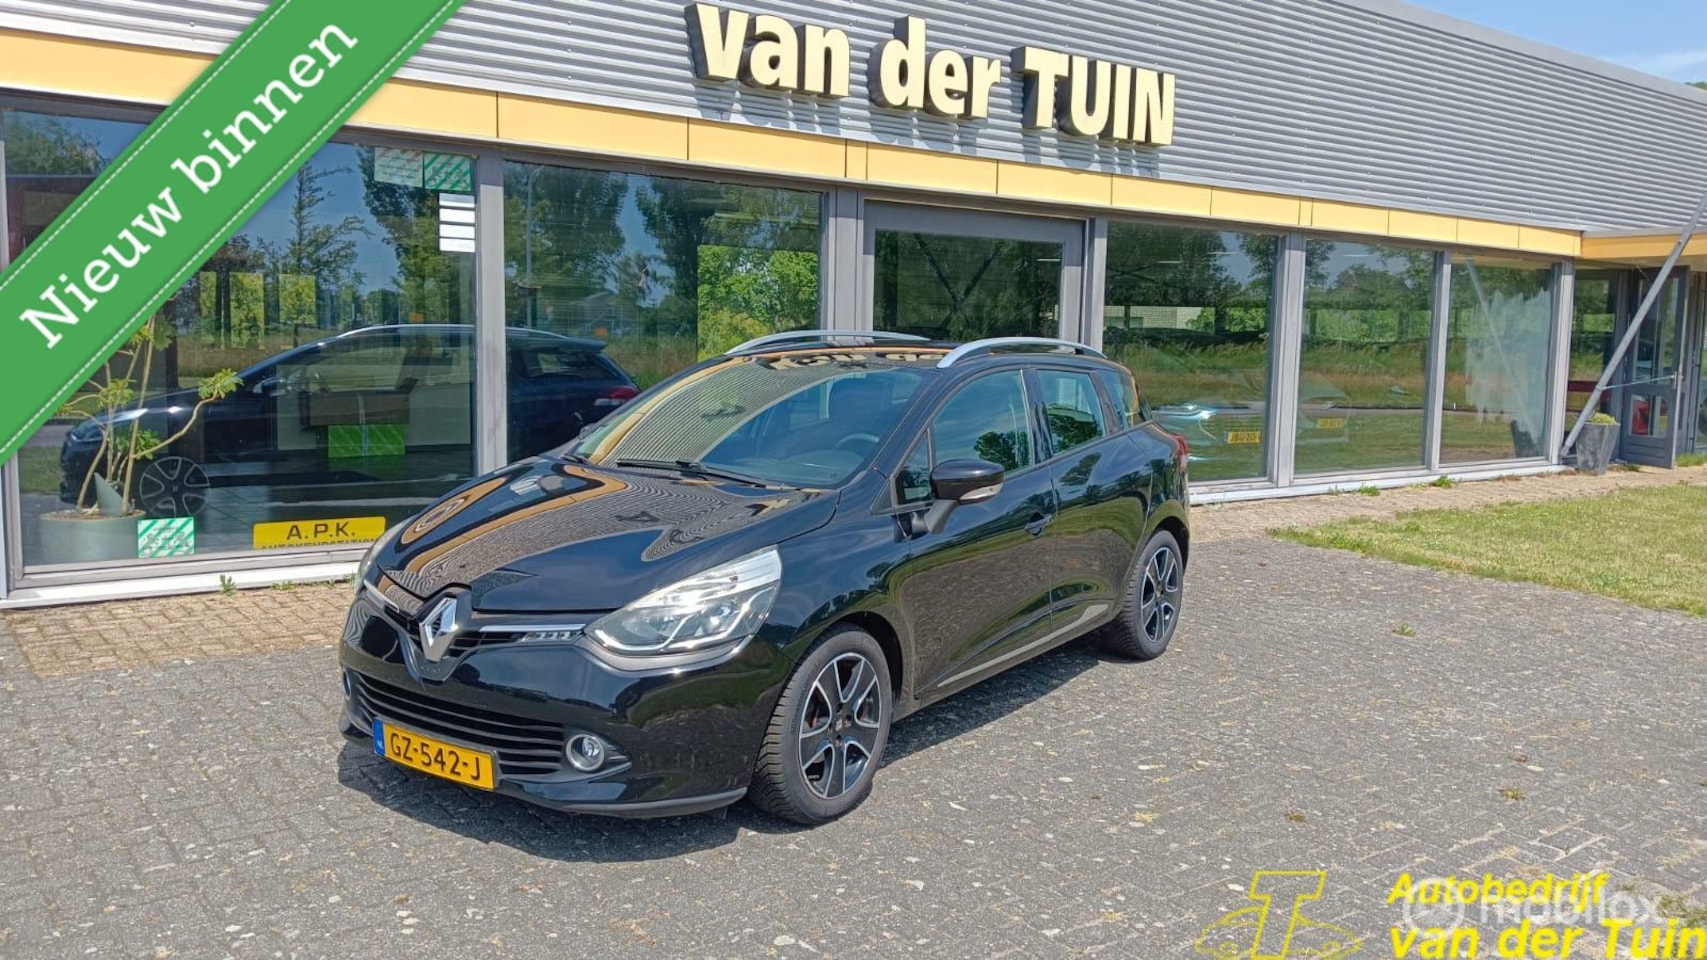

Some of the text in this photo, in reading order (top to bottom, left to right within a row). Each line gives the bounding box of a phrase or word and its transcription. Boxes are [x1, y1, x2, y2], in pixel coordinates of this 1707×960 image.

[690, 2, 1176, 147] van der TUIN
[286, 521, 356, 540] A.P.K.
[389, 732, 482, 781] GZ-542-J
